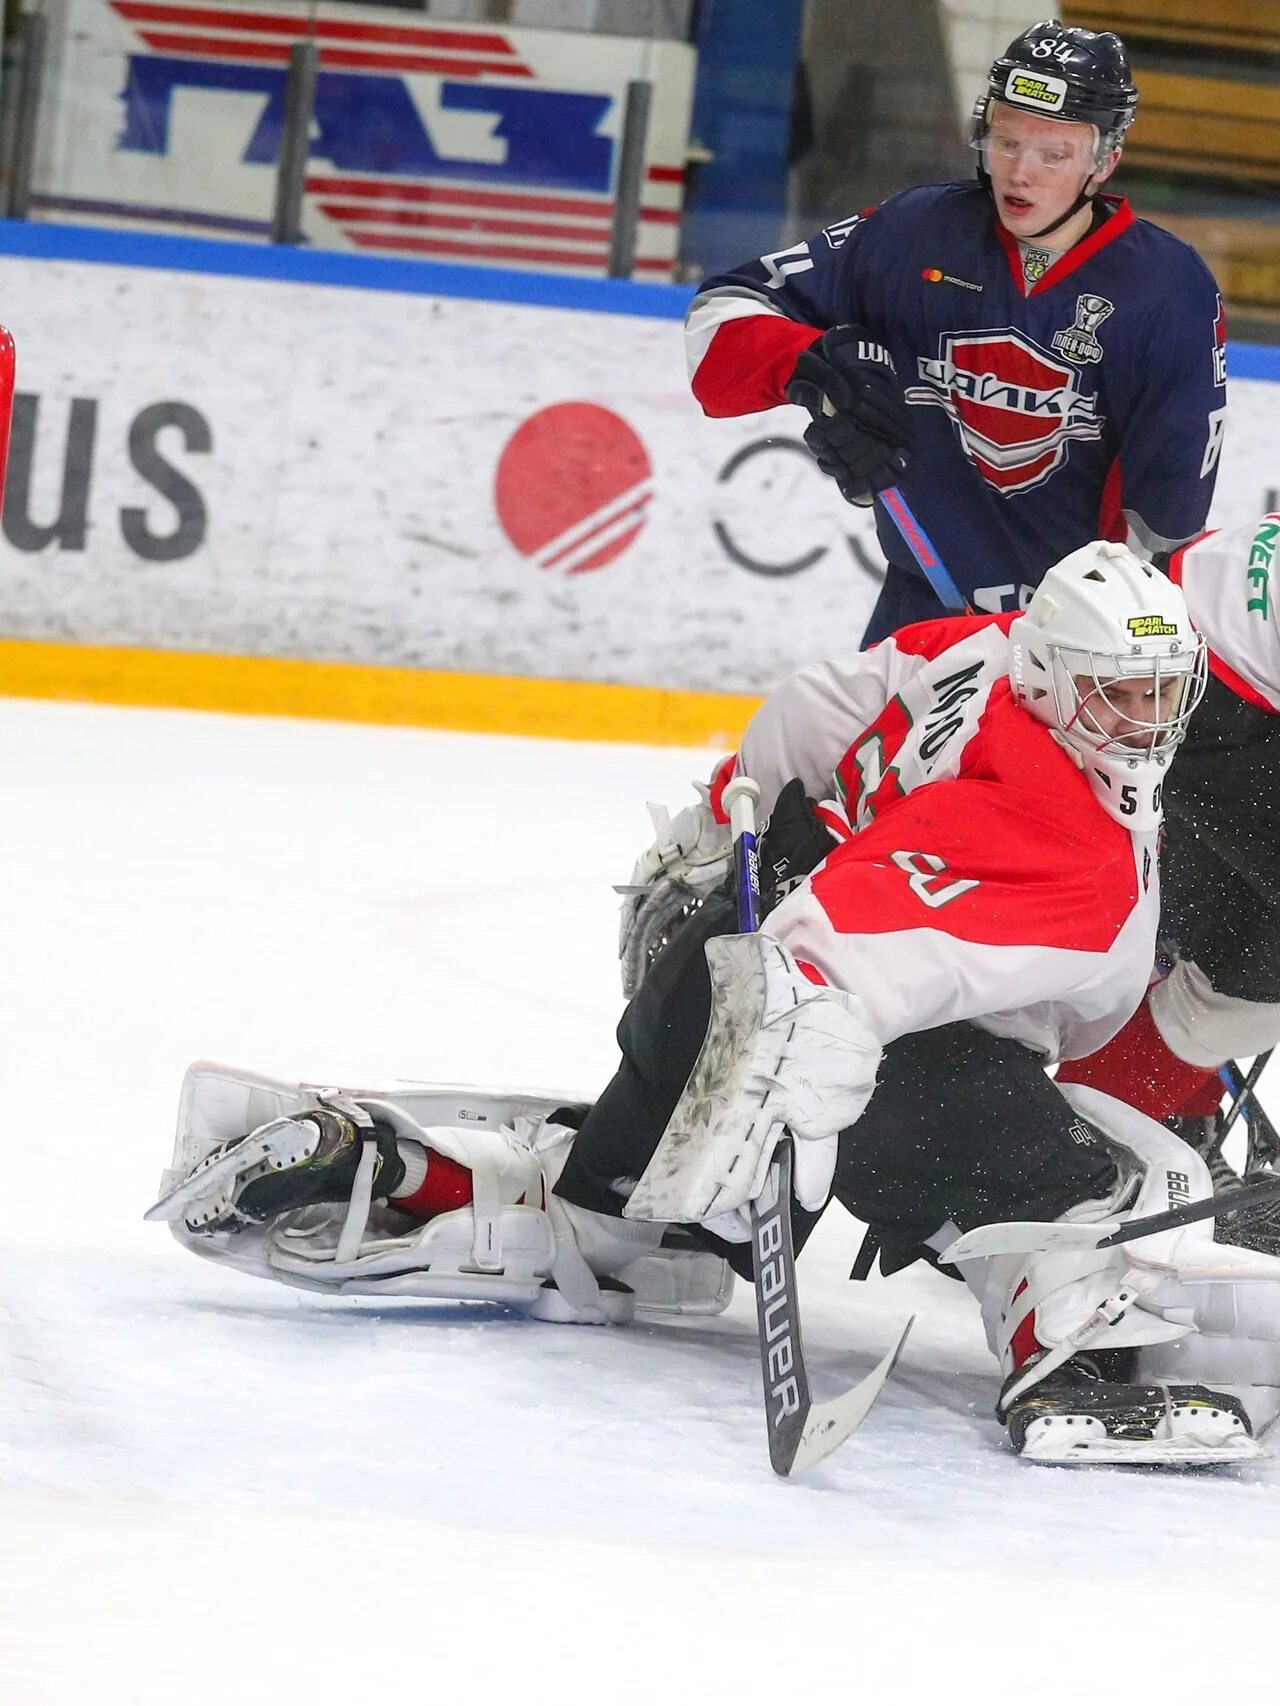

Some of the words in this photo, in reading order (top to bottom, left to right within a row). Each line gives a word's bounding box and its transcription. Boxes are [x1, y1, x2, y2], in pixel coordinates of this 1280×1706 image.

[1031, 38, 1074, 64] 84
[1015, 76, 1046, 91] PARI
[1018, 85, 1057, 103] MATCH
[943, 275, 984, 292] mastercard
[1129, 618, 1162, 628] PARI
[1136, 624, 1177, 636] MATCH
[757, 1214, 800, 1428] BAUER
